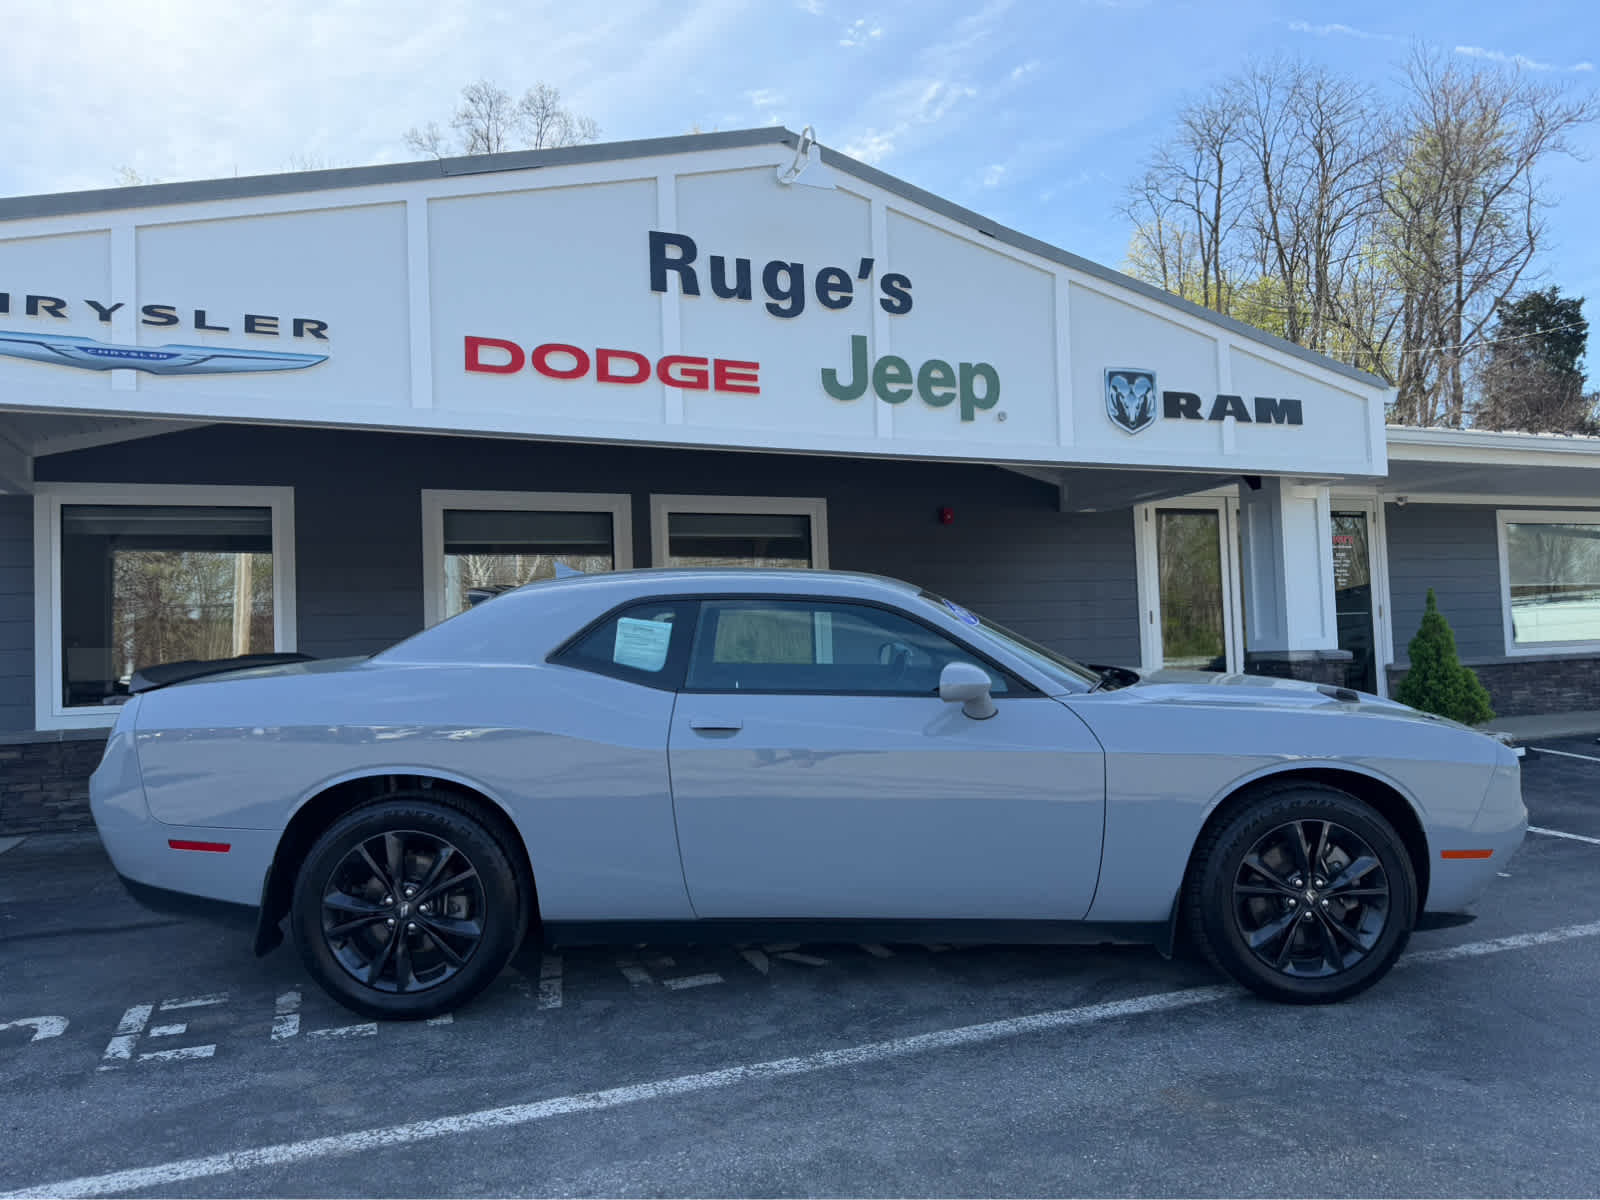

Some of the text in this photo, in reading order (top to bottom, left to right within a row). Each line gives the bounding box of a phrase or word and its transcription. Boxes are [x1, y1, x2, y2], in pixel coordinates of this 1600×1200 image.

[648, 230, 914, 319] Ruge's
[0, 292, 329, 340] RYSLER
[464, 335, 761, 395] DODGE
[821, 334, 1001, 422] Jeep
[1162, 391, 1304, 426] RAM
